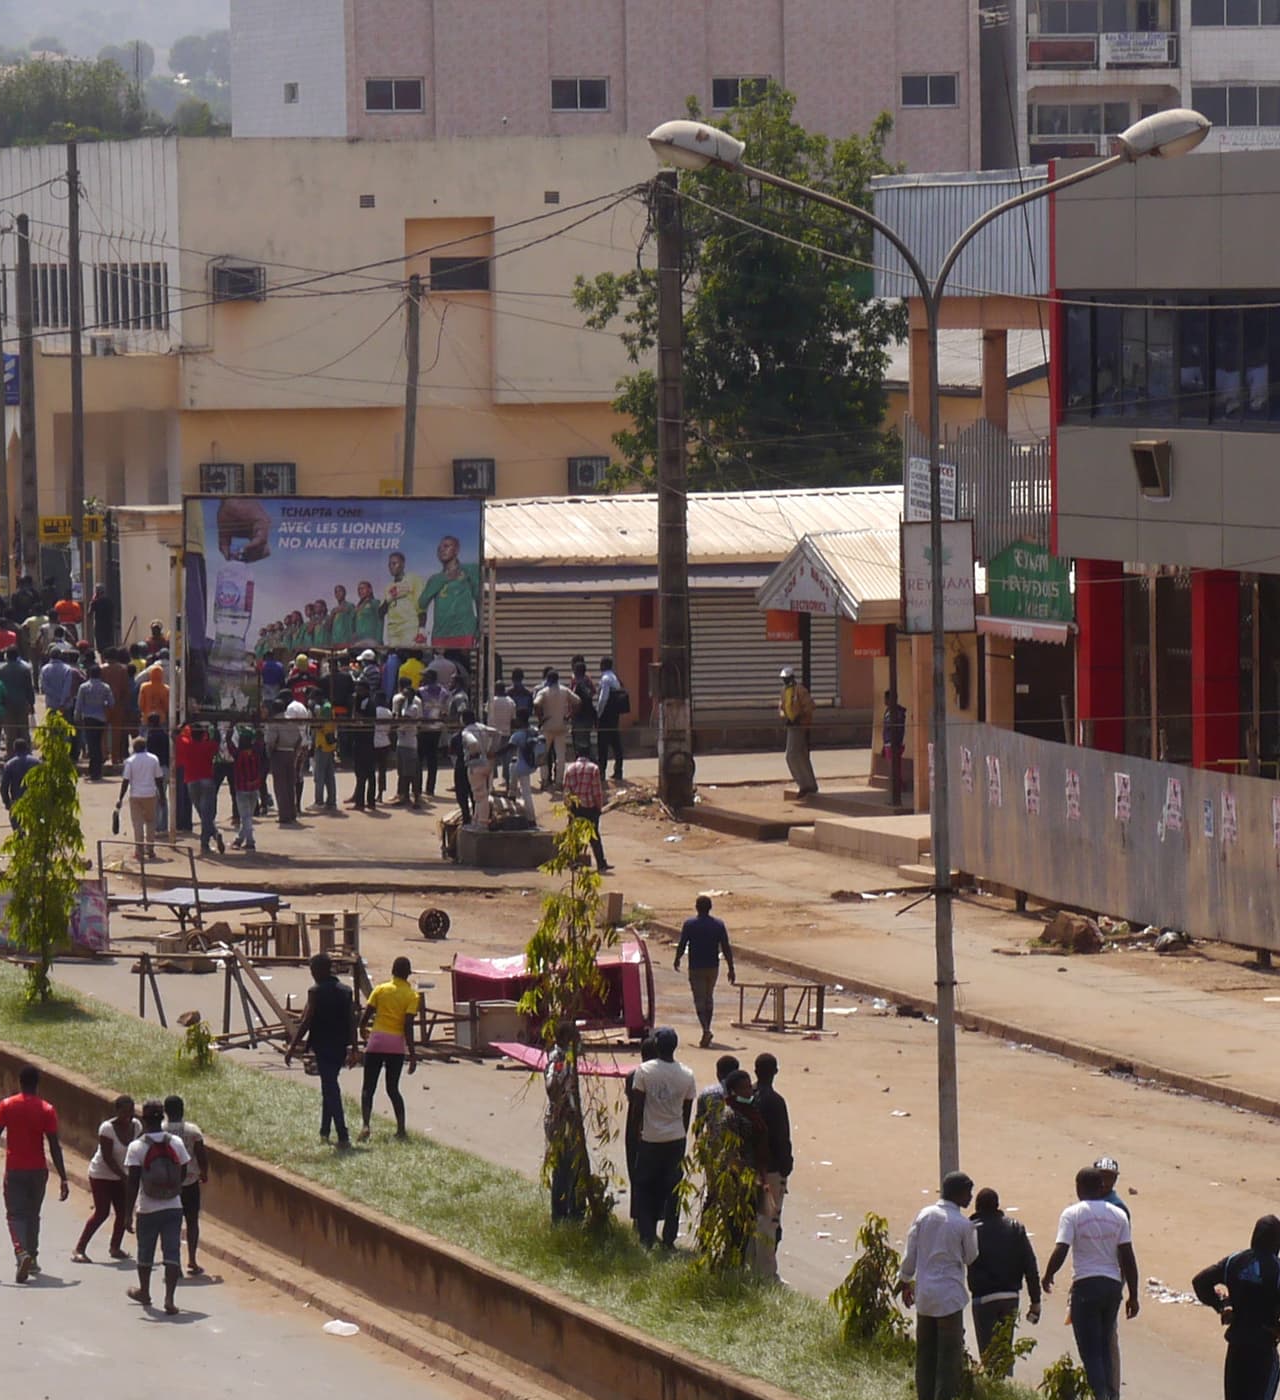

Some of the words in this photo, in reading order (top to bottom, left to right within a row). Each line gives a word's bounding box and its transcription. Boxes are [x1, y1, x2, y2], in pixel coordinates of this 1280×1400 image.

[280, 507, 332, 518] TCHAPTA
[278, 522, 312, 534] AVEC
[316, 522, 338, 533] LES
[342, 522, 406, 536] LIONNES,
[278, 537, 301, 549] NO
[304, 537, 346, 549] MAKE
[350, 538, 401, 549] ERREUR
